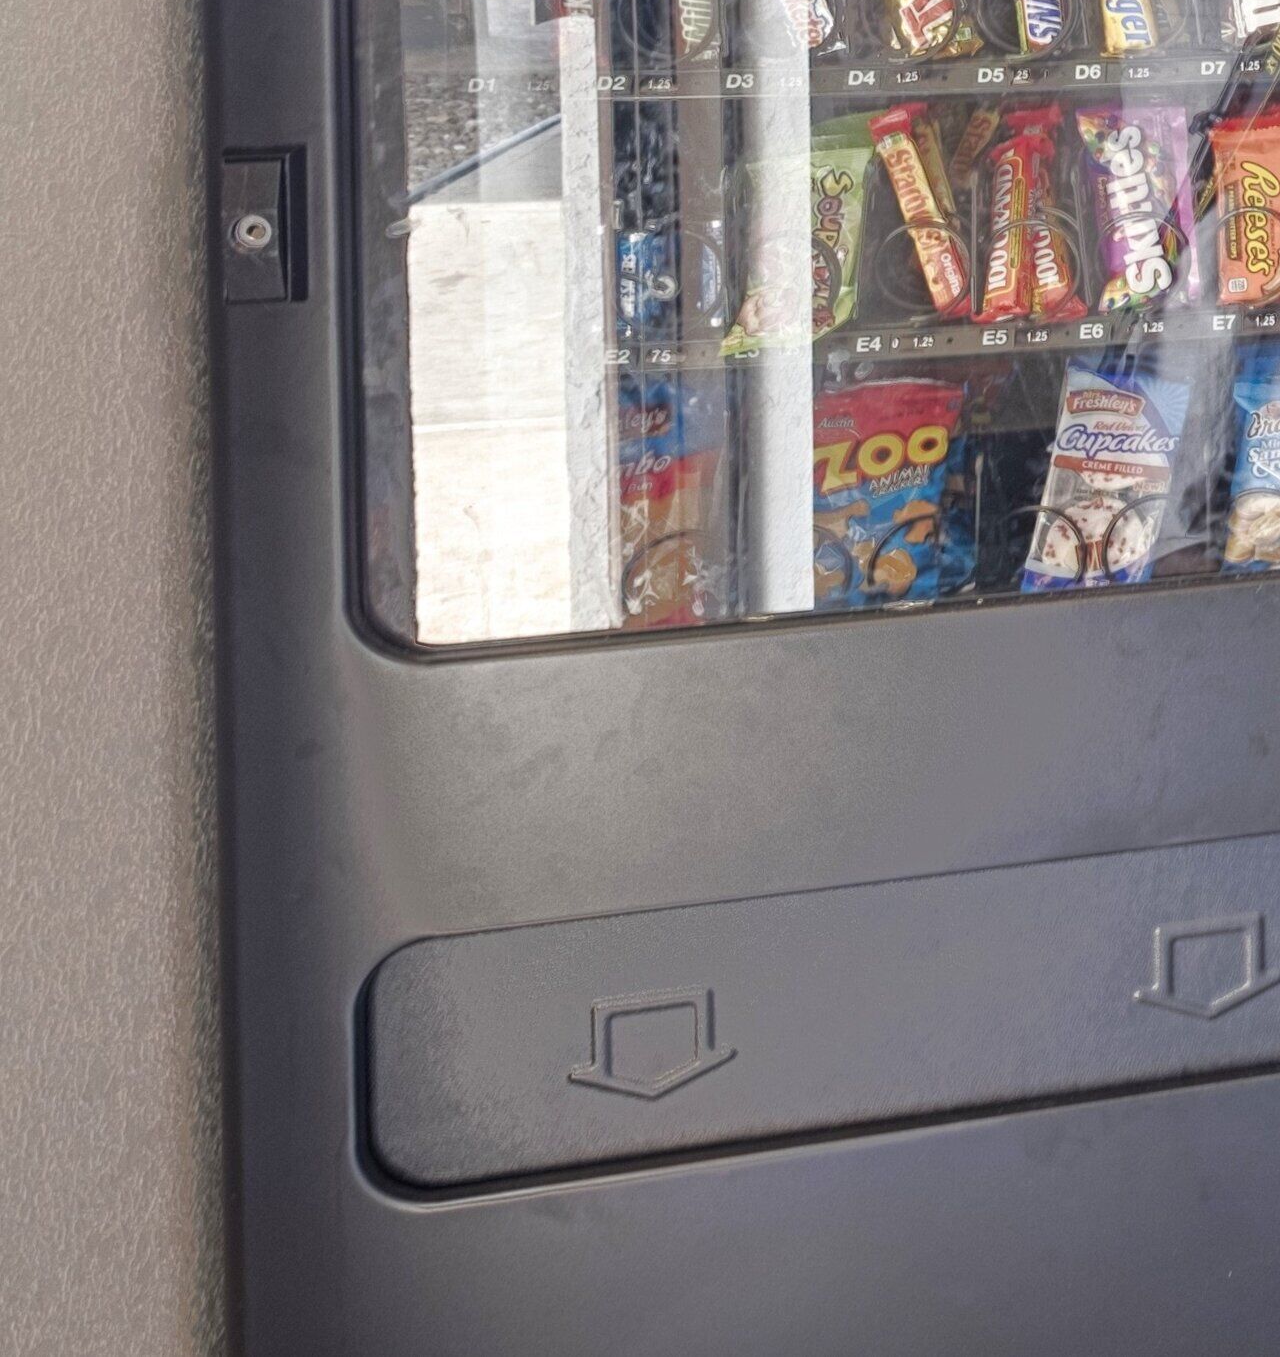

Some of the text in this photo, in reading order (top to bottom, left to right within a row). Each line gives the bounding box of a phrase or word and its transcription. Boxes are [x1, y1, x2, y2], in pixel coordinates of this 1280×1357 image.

[848, 70, 919, 86] D4 1.25
[977, 68, 1005, 83] D5
[1075, 64, 1150, 80] D6 1.25
[468, 78, 495, 92] D1
[597, 76, 626, 91] D2
[988, 163, 1014, 291] 100 GRAND
[1079, 322, 1164, 339] E6 1.25
[1212, 315, 1276, 331] E7 1.25
[856, 336, 882, 353] E4
[982, 330, 1048, 346] E5 1.25
[1072, 394, 1138, 416] Freshley's
[818, 417, 856, 429] Austin
[1056, 423, 1180, 461] Cupcakes
[813, 425, 949, 496] ZOO
[1081, 460, 1144, 475] CREME FILLED
[869, 464, 930, 491] ANIMAL
